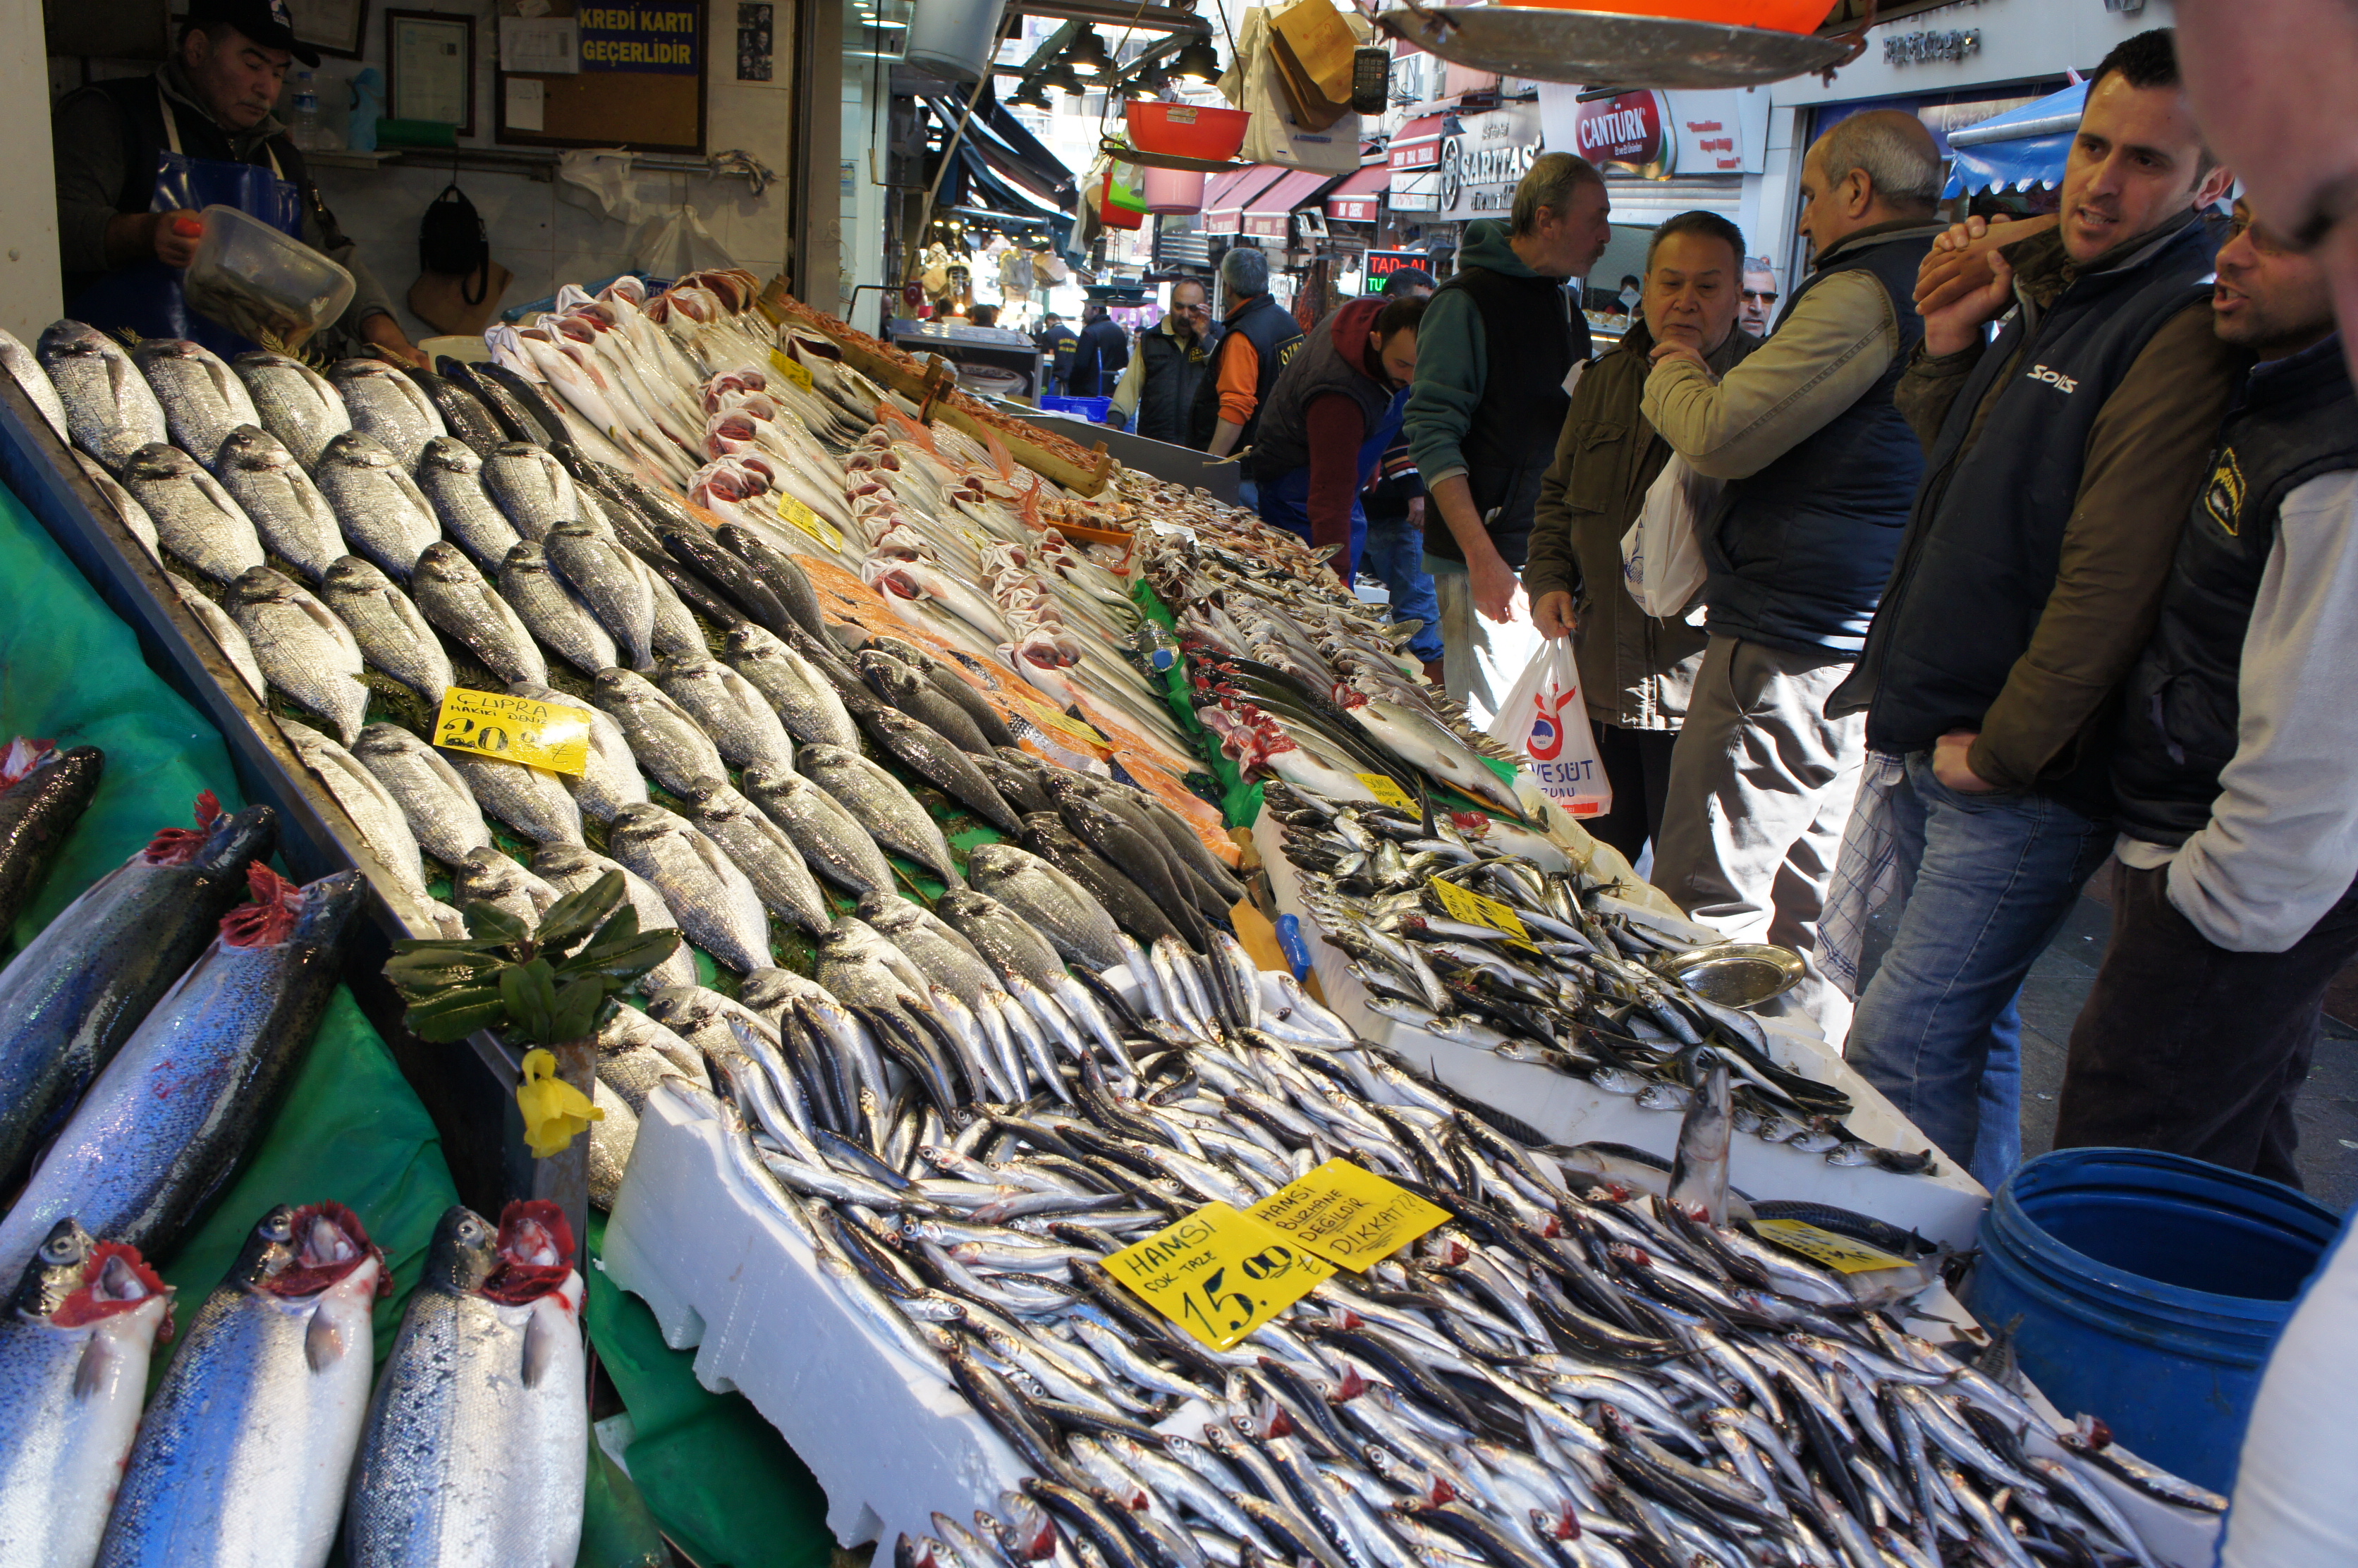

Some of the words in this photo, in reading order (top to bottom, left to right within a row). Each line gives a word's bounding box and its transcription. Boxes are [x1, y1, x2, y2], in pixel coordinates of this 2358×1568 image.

[580, 5, 635, 30] KREDİ
[641, 11, 693, 33] KARTI
[582, 38, 691, 67] GEÇERLİDİR
[1581, 103, 1647, 149] CANTÜRK
[1368, 278, 1388, 291] TU
[457, 693, 547, 718] ÇUPRA
[1556, 759, 1593, 783] SÜT
[1259, 1182, 1317, 1223] HAMSİ
[1124, 1215, 1218, 1278] HAMSİ
[1143, 1270, 1180, 1293] ÇOK
[1179, 1250, 1218, 1280] TAZE
